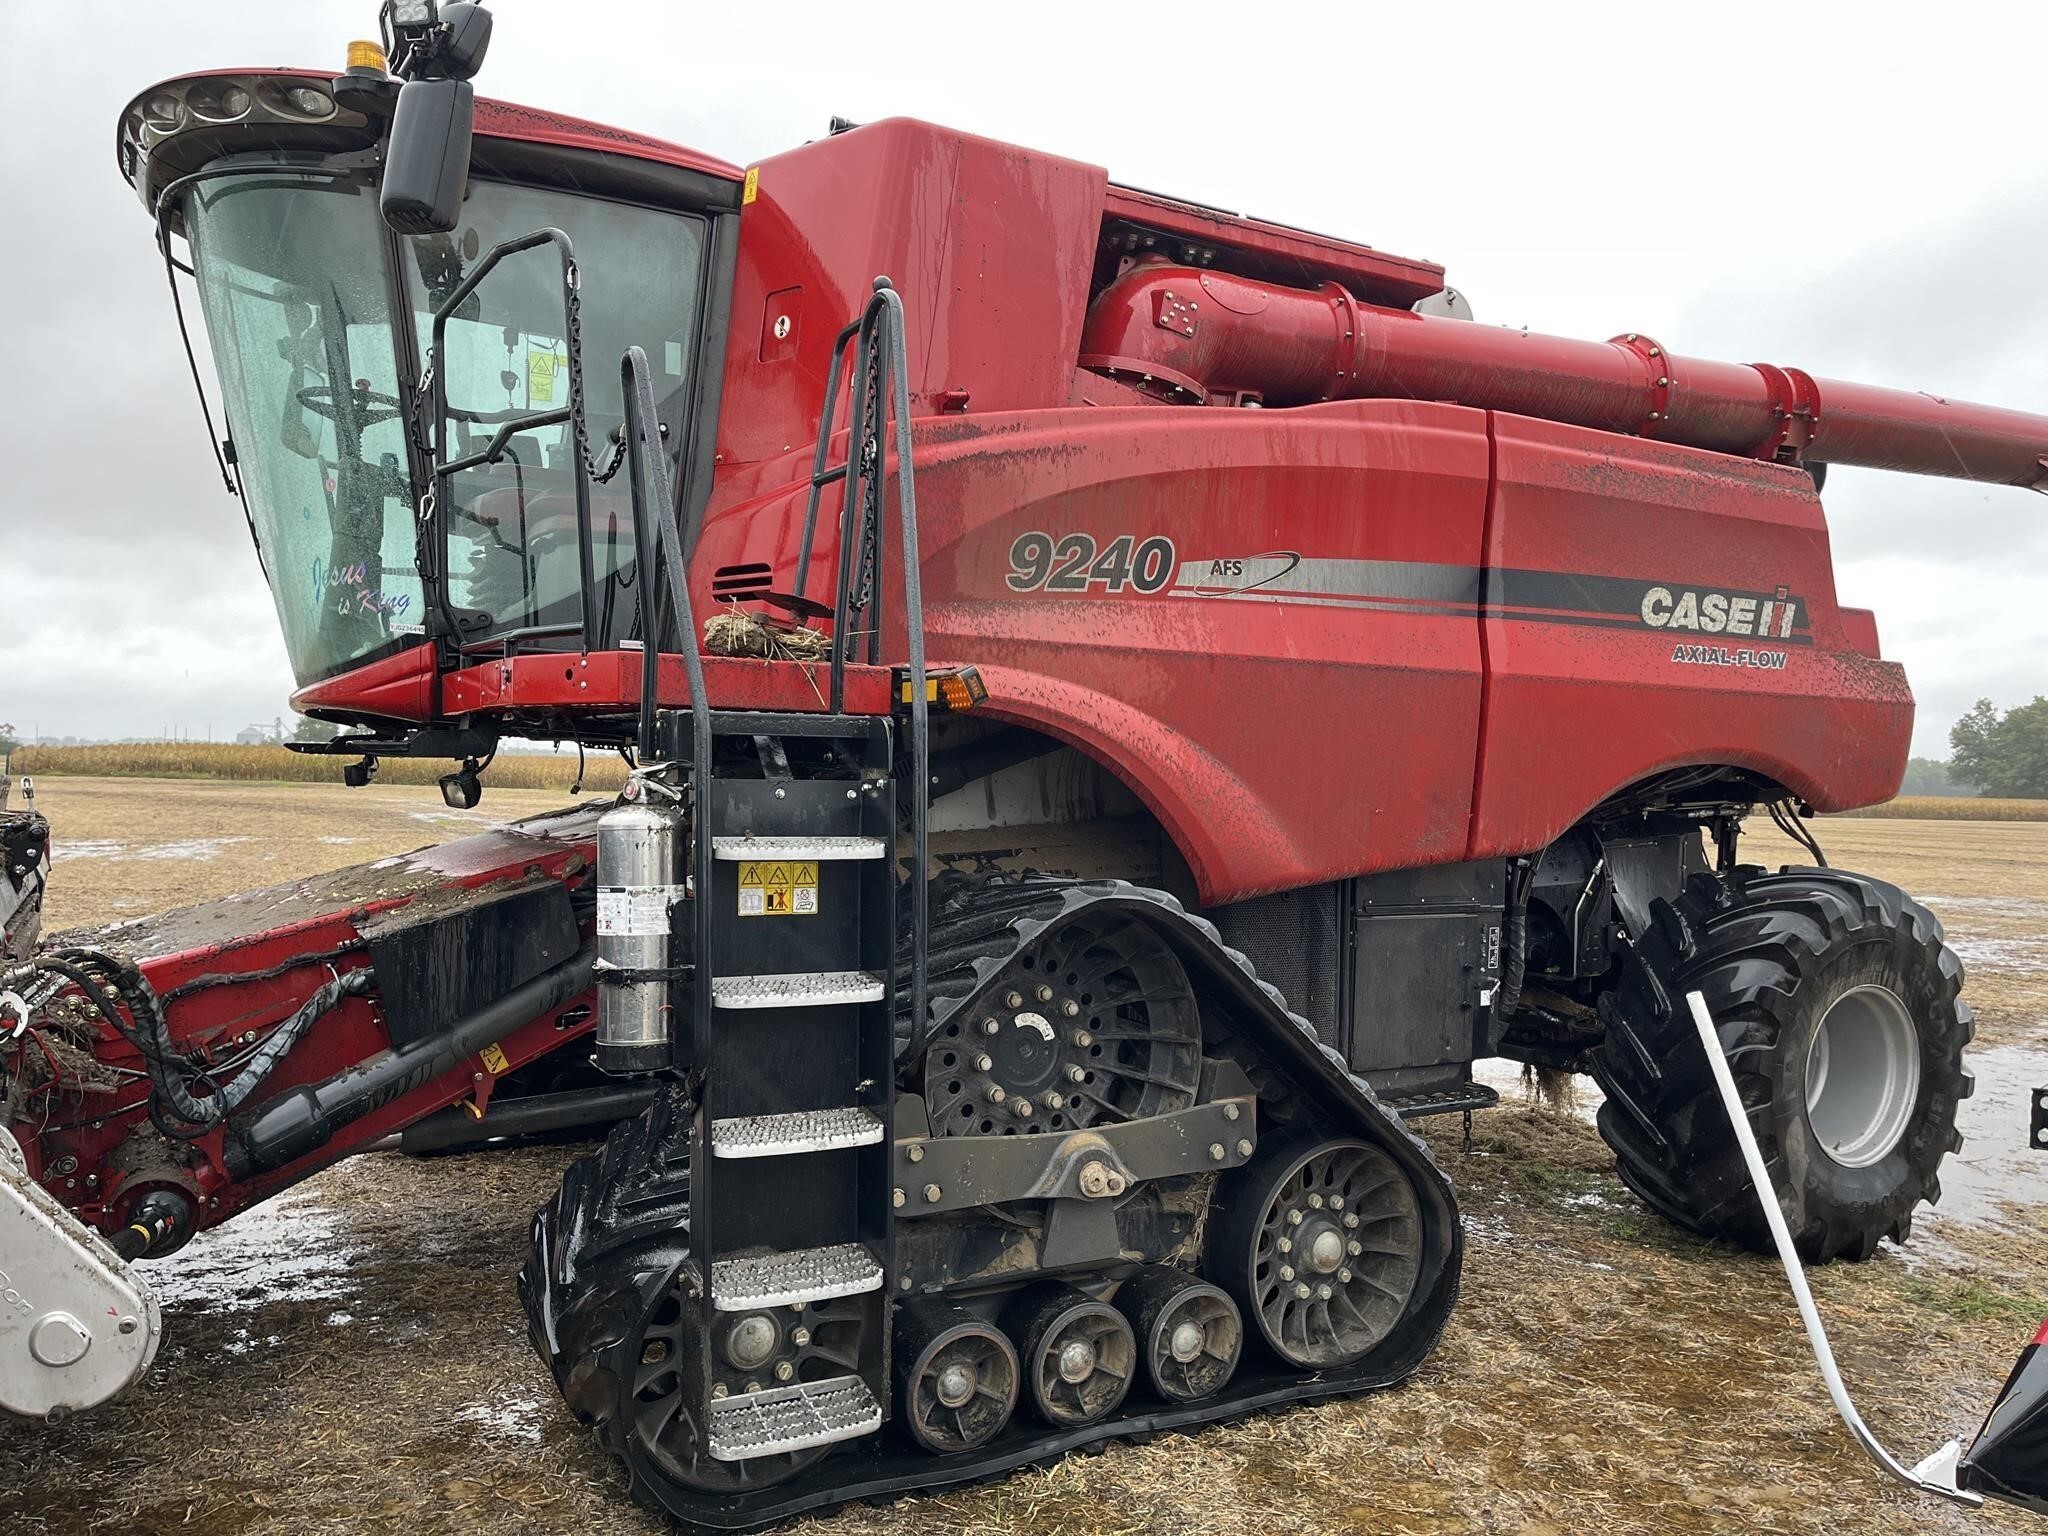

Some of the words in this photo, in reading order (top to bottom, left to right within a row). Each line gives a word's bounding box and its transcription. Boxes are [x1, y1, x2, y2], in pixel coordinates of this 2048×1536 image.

[312, 557, 368, 605] Jesus
[1005, 531, 1175, 594] 9240
[1210, 559, 1243, 577] AFS
[338, 596, 350, 615] is
[356, 587, 411, 616] King
[1641, 586, 1757, 634] CASE
[1671, 644, 1788, 669] AXIAL-FLOW
